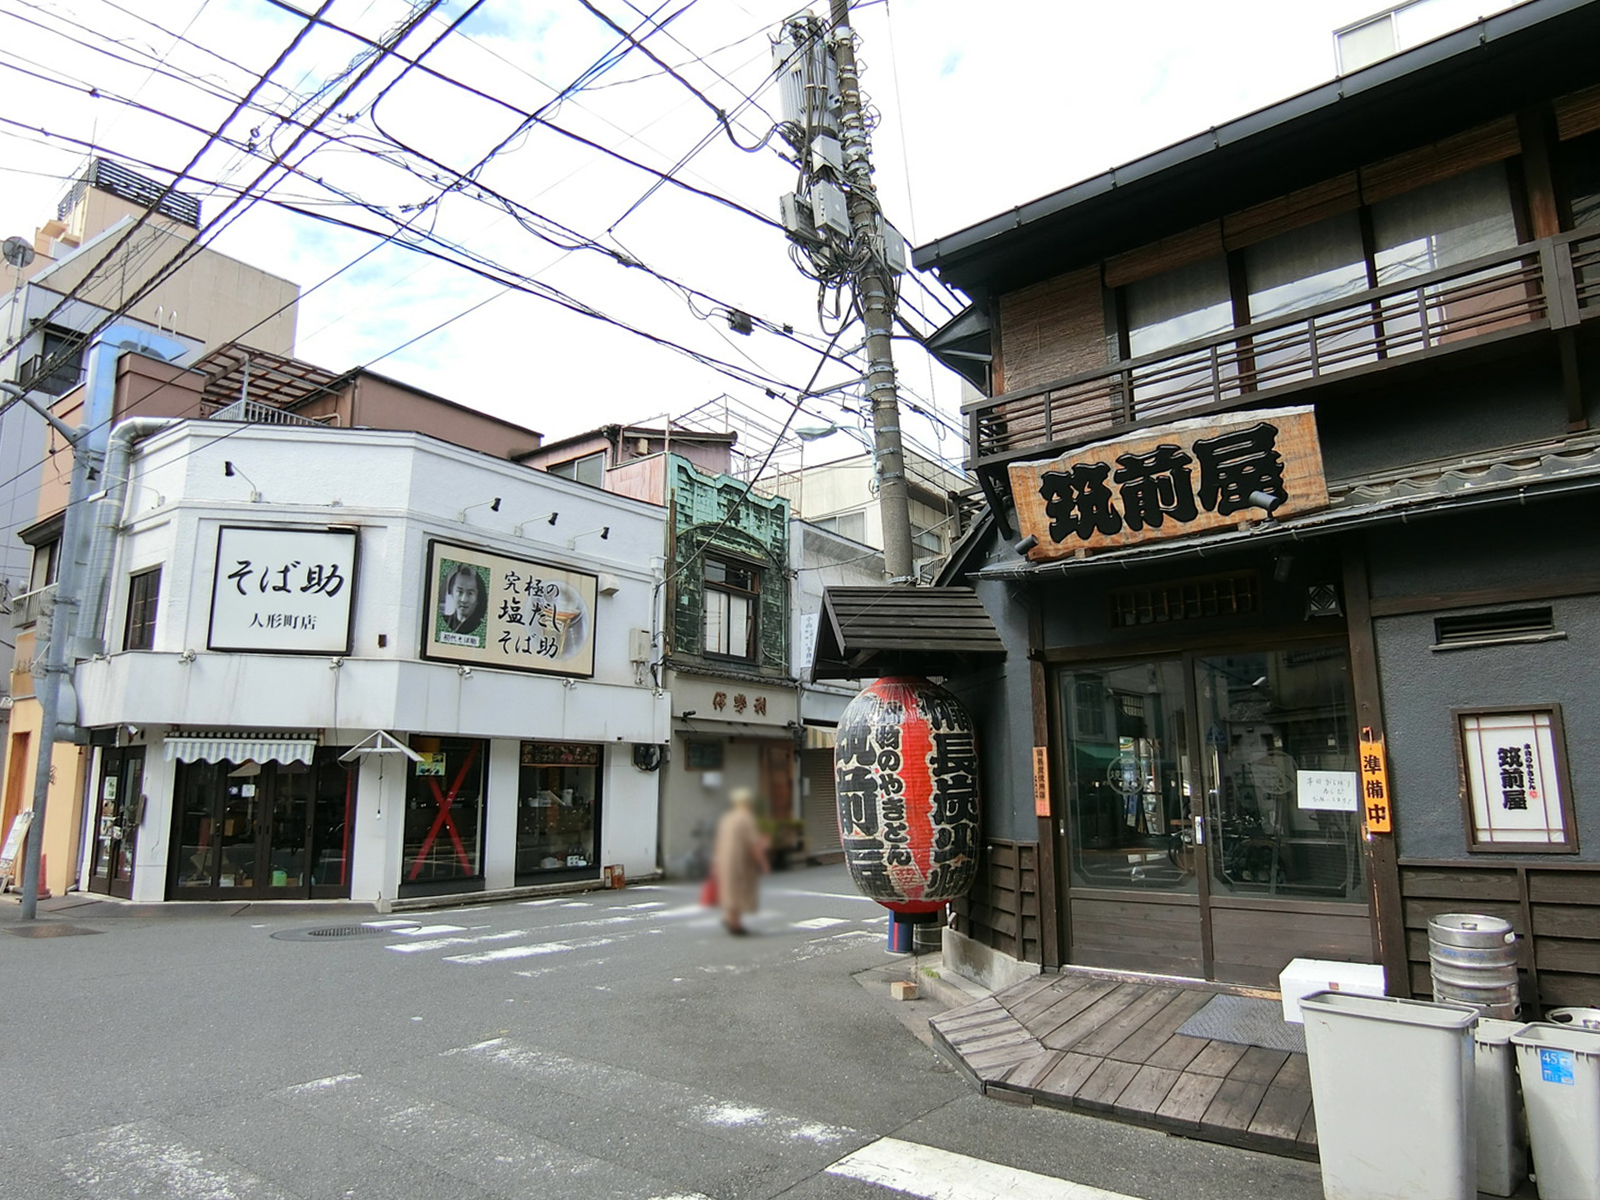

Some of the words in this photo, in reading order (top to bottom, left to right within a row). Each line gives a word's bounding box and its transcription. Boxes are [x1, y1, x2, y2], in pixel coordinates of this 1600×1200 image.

[1039, 422, 1288, 544] 筑前屋
[227, 560, 345, 597] そば助
[503, 571, 559, 597] 究極の
[249, 613, 317, 630] 人形町店
[498, 597, 562, 633] 塩だし
[498, 631, 559, 659] そば助
[1363, 754, 1386, 825] 準備中
[1497, 747, 1528, 811] 筑前屋
[1542, 1052, 1558, 1065] 45
